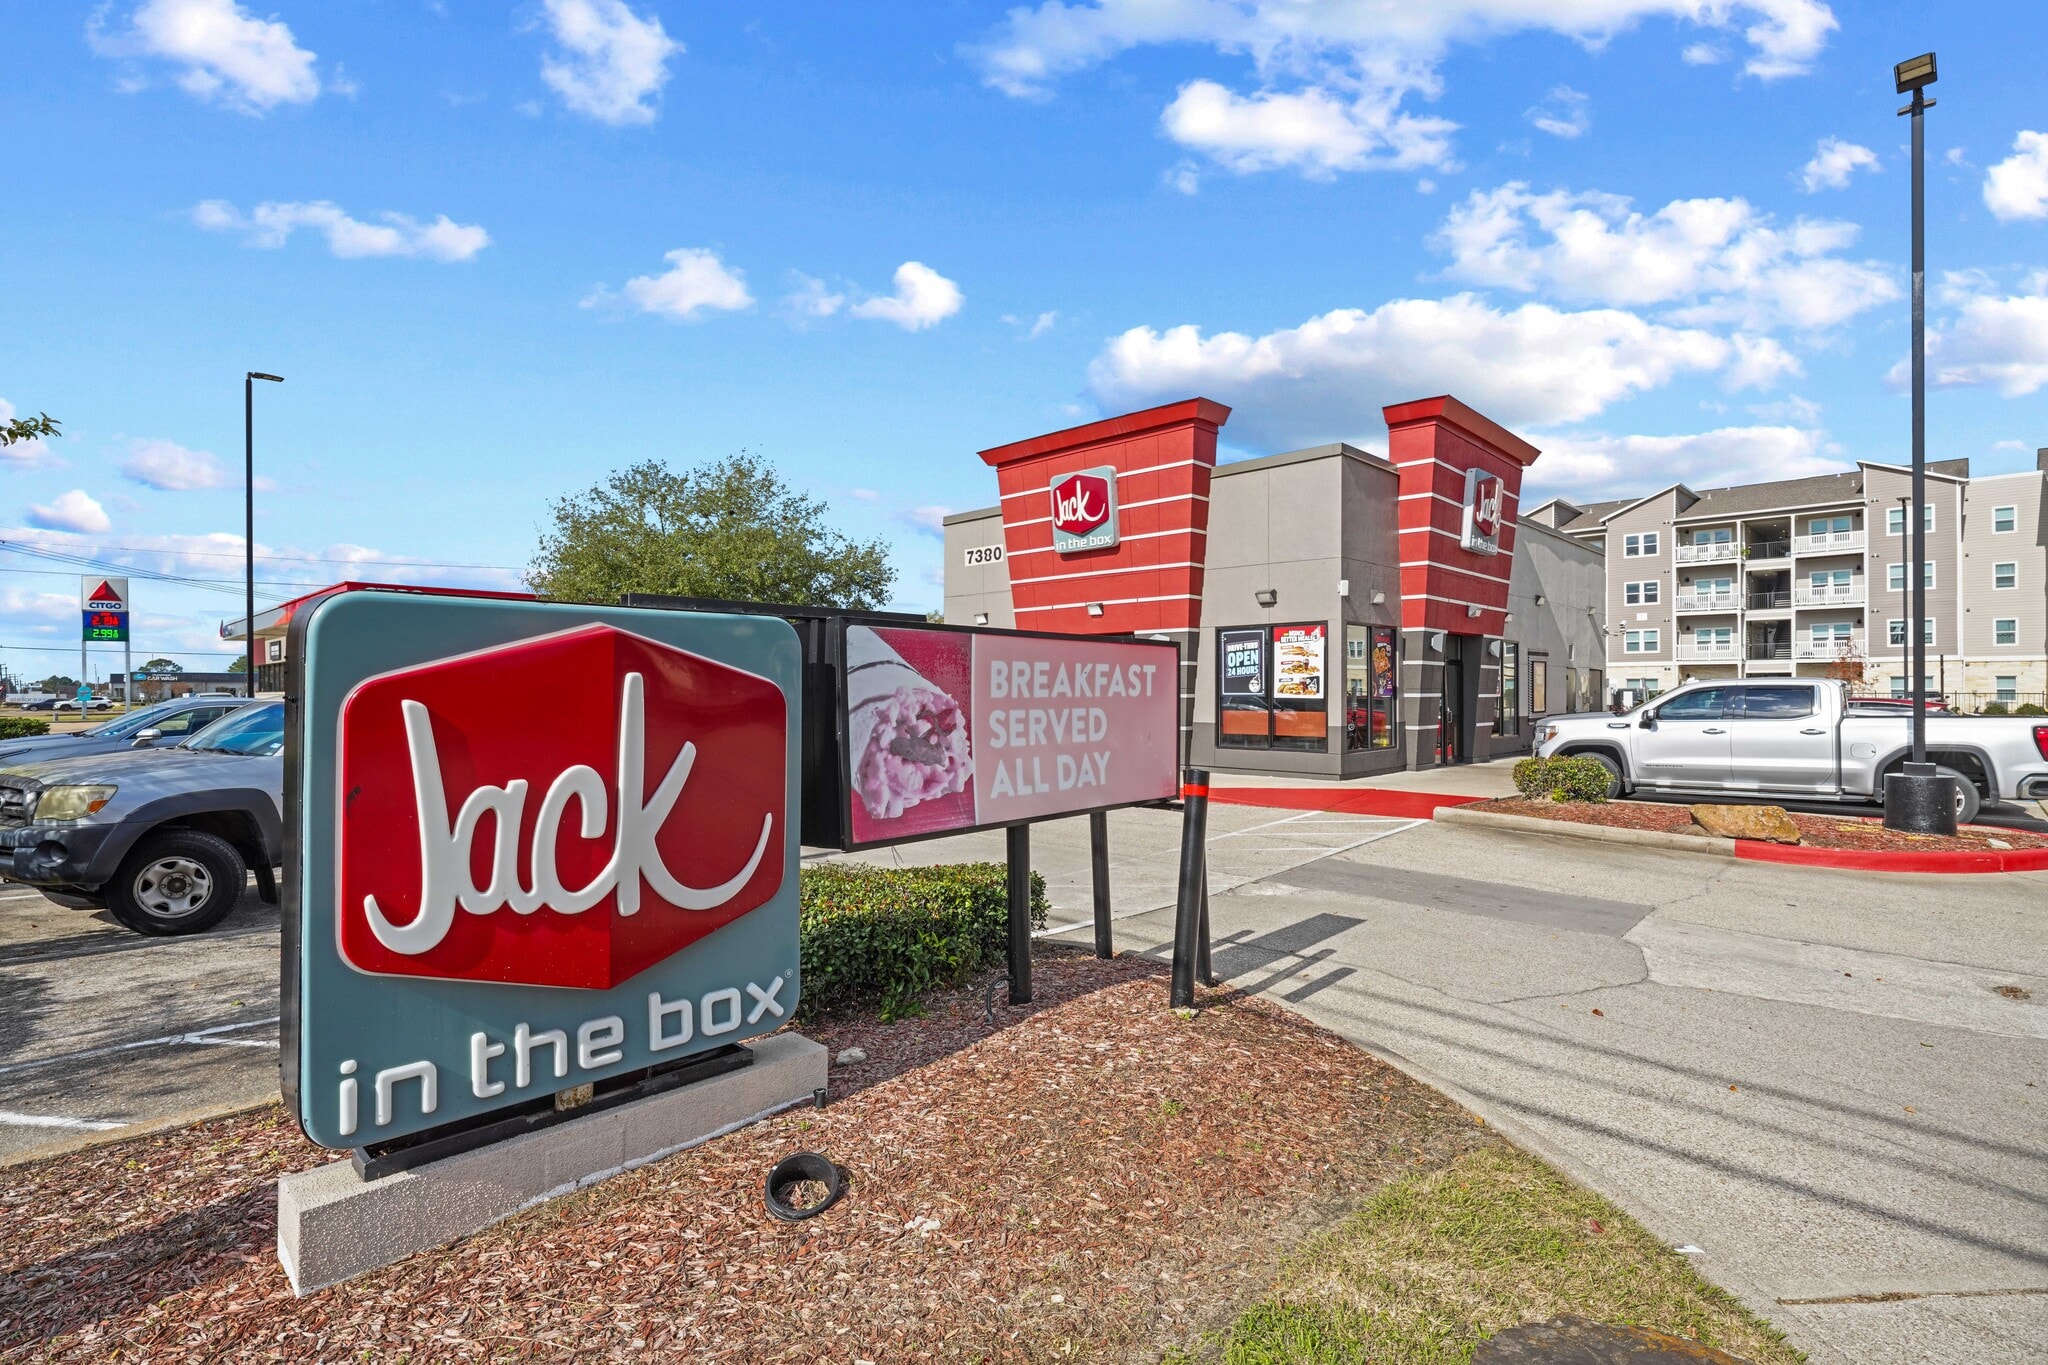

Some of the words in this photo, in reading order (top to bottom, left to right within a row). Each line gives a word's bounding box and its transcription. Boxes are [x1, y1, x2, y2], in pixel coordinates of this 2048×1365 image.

[1054, 480, 1106, 527] Jack
[966, 546, 1002, 565] 7380
[1055, 540, 1067, 551] in
[1068, 537, 1088, 549] the
[1089, 534, 1112, 547] box
[1228, 650, 1259, 668] OPEN
[1228, 667, 1236, 677] 24
[1236, 665, 1259, 676] HOURS
[989, 660, 1157, 699] BREAKFAST
[988, 707, 1108, 749] SERVED
[989, 755, 1050, 800] ALL
[1057, 750, 1112, 792] DAY
[363, 672, 773, 956] Jack
[339, 1059, 438, 1137] in
[470, 1014, 625, 1099] the
[648, 975, 785, 1053] box
